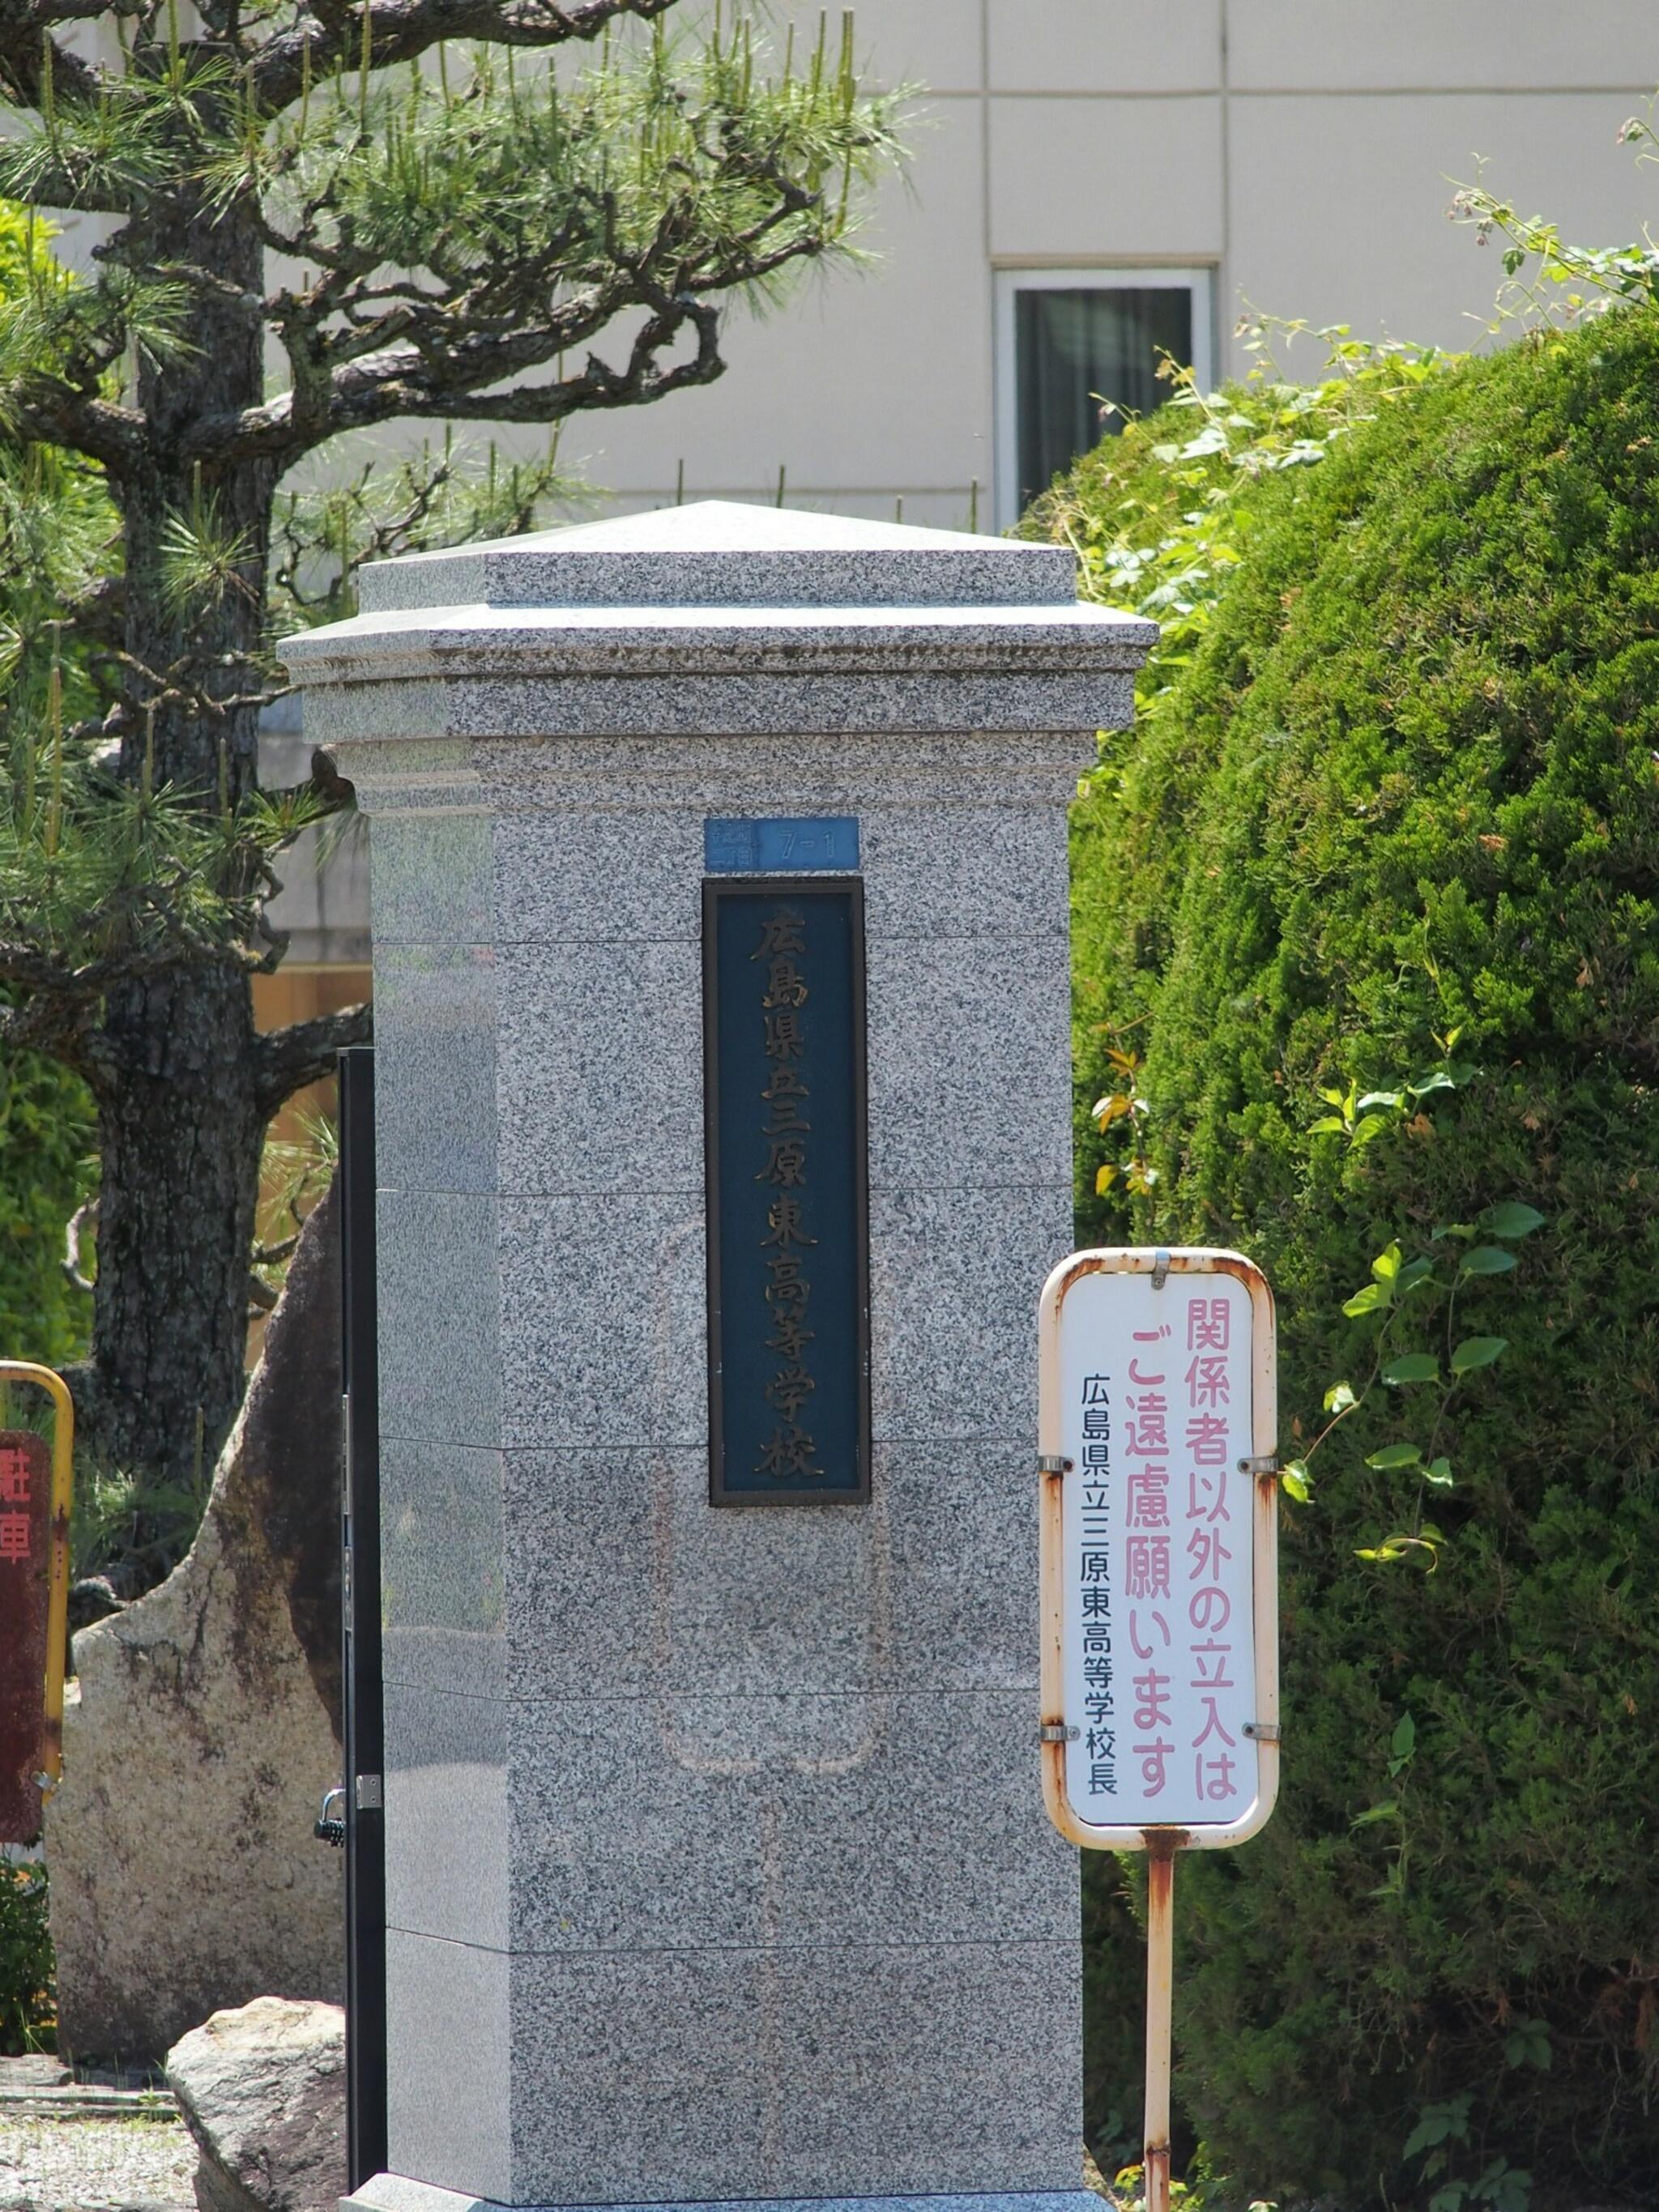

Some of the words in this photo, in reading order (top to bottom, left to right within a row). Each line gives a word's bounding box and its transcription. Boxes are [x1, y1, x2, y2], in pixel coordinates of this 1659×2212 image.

[778, 829, 836, 859] 7-1
[750, 905, 825, 1477] 広島県立三原東高等学校
[1080, 1373, 1118, 1796] 広島県立三原東高等学校長
[1124, 1323, 1175, 1798] ご遠慮願います
[1183, 1298, 1238, 1801] 関係者以外の立入は
